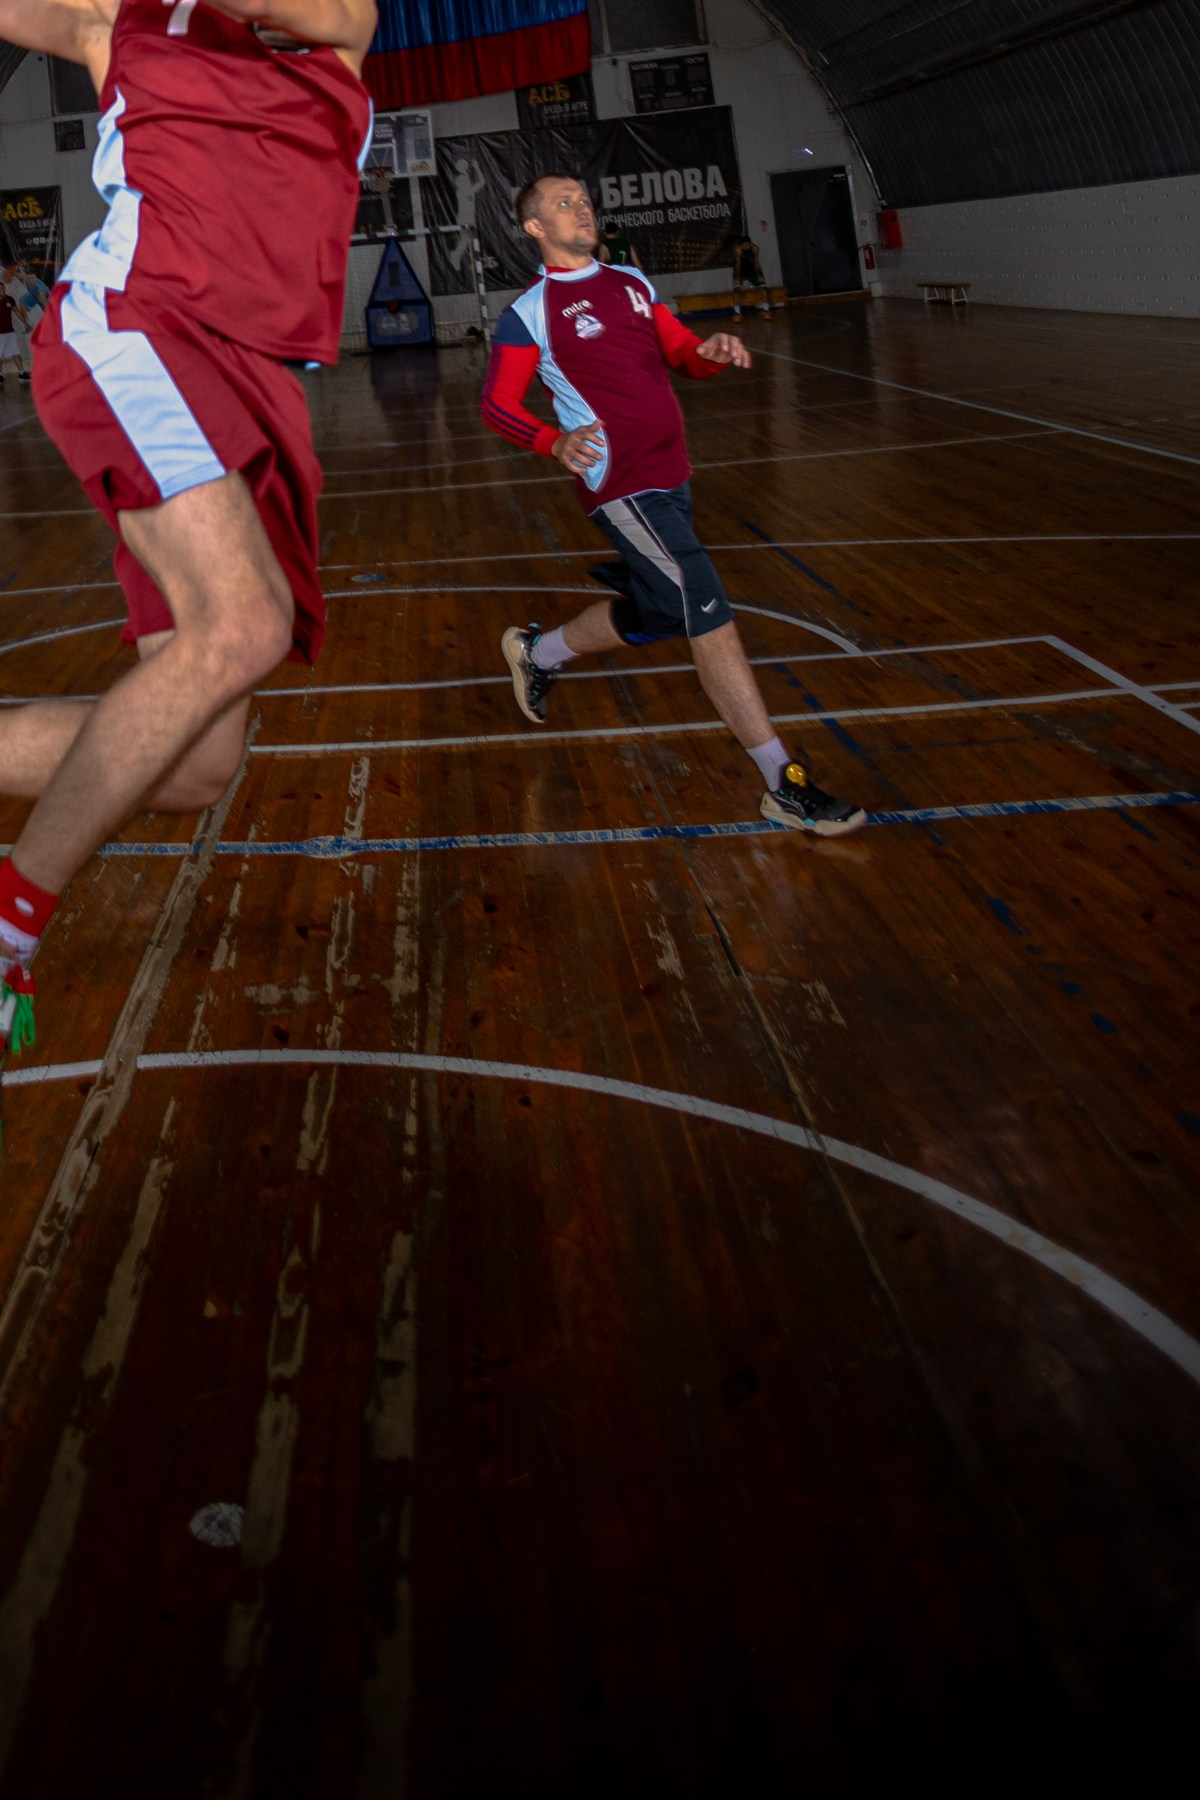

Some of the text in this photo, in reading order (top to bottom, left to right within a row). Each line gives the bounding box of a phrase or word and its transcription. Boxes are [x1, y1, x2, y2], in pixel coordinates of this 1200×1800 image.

[528, 82, 571, 105] АСБ
[543, 103, 562, 114] БУДЬ
[599, 165, 729, 209] БЕЛОВА
[2, 195, 43, 220] АСБ
[594, 203, 731, 230] УДЕНЧЕСКОГО БАСКЕТБОЛА
[619, 250, 628, 265] 7
[561, 299, 593, 319] mitre
[624, 286, 652, 319] 4
